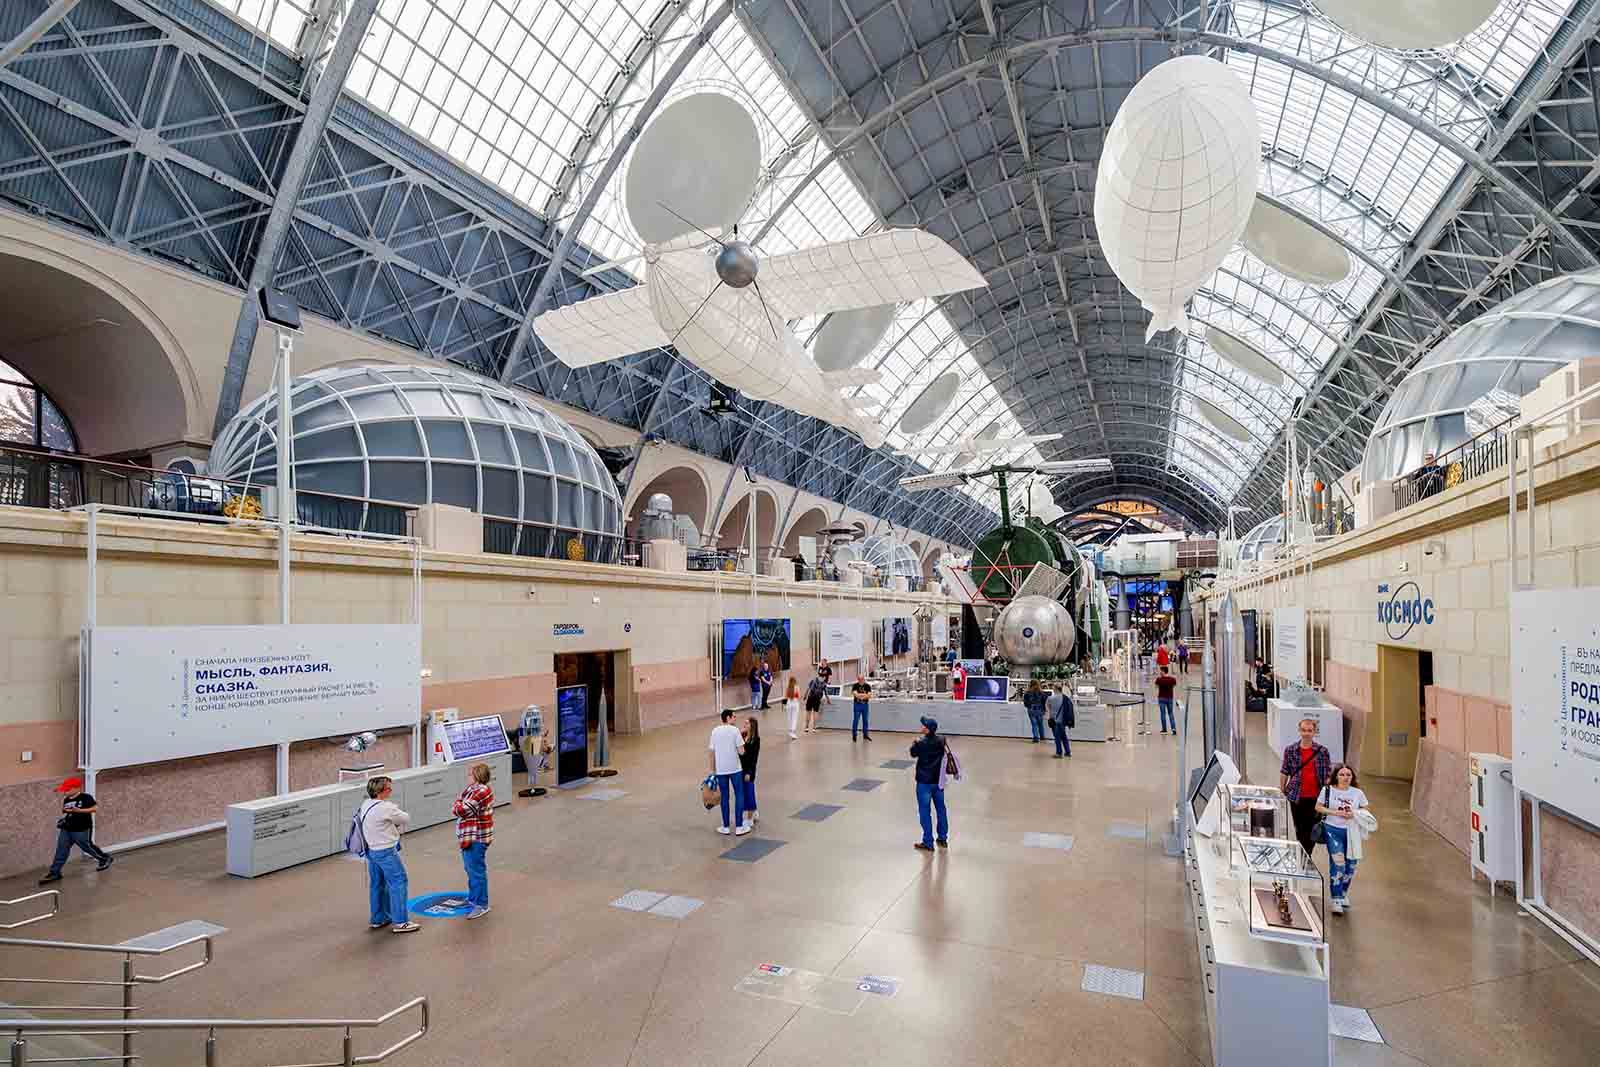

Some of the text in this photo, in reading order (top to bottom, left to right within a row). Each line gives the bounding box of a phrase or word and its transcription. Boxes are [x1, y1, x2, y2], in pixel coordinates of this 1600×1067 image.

[1377, 599, 1434, 625] КОСМОС
[259, 663, 333, 676] ФАНТАЗИЯ,
[195, 681, 258, 694] СКАЗКА.
[1571, 681, 1600, 704] РОД
